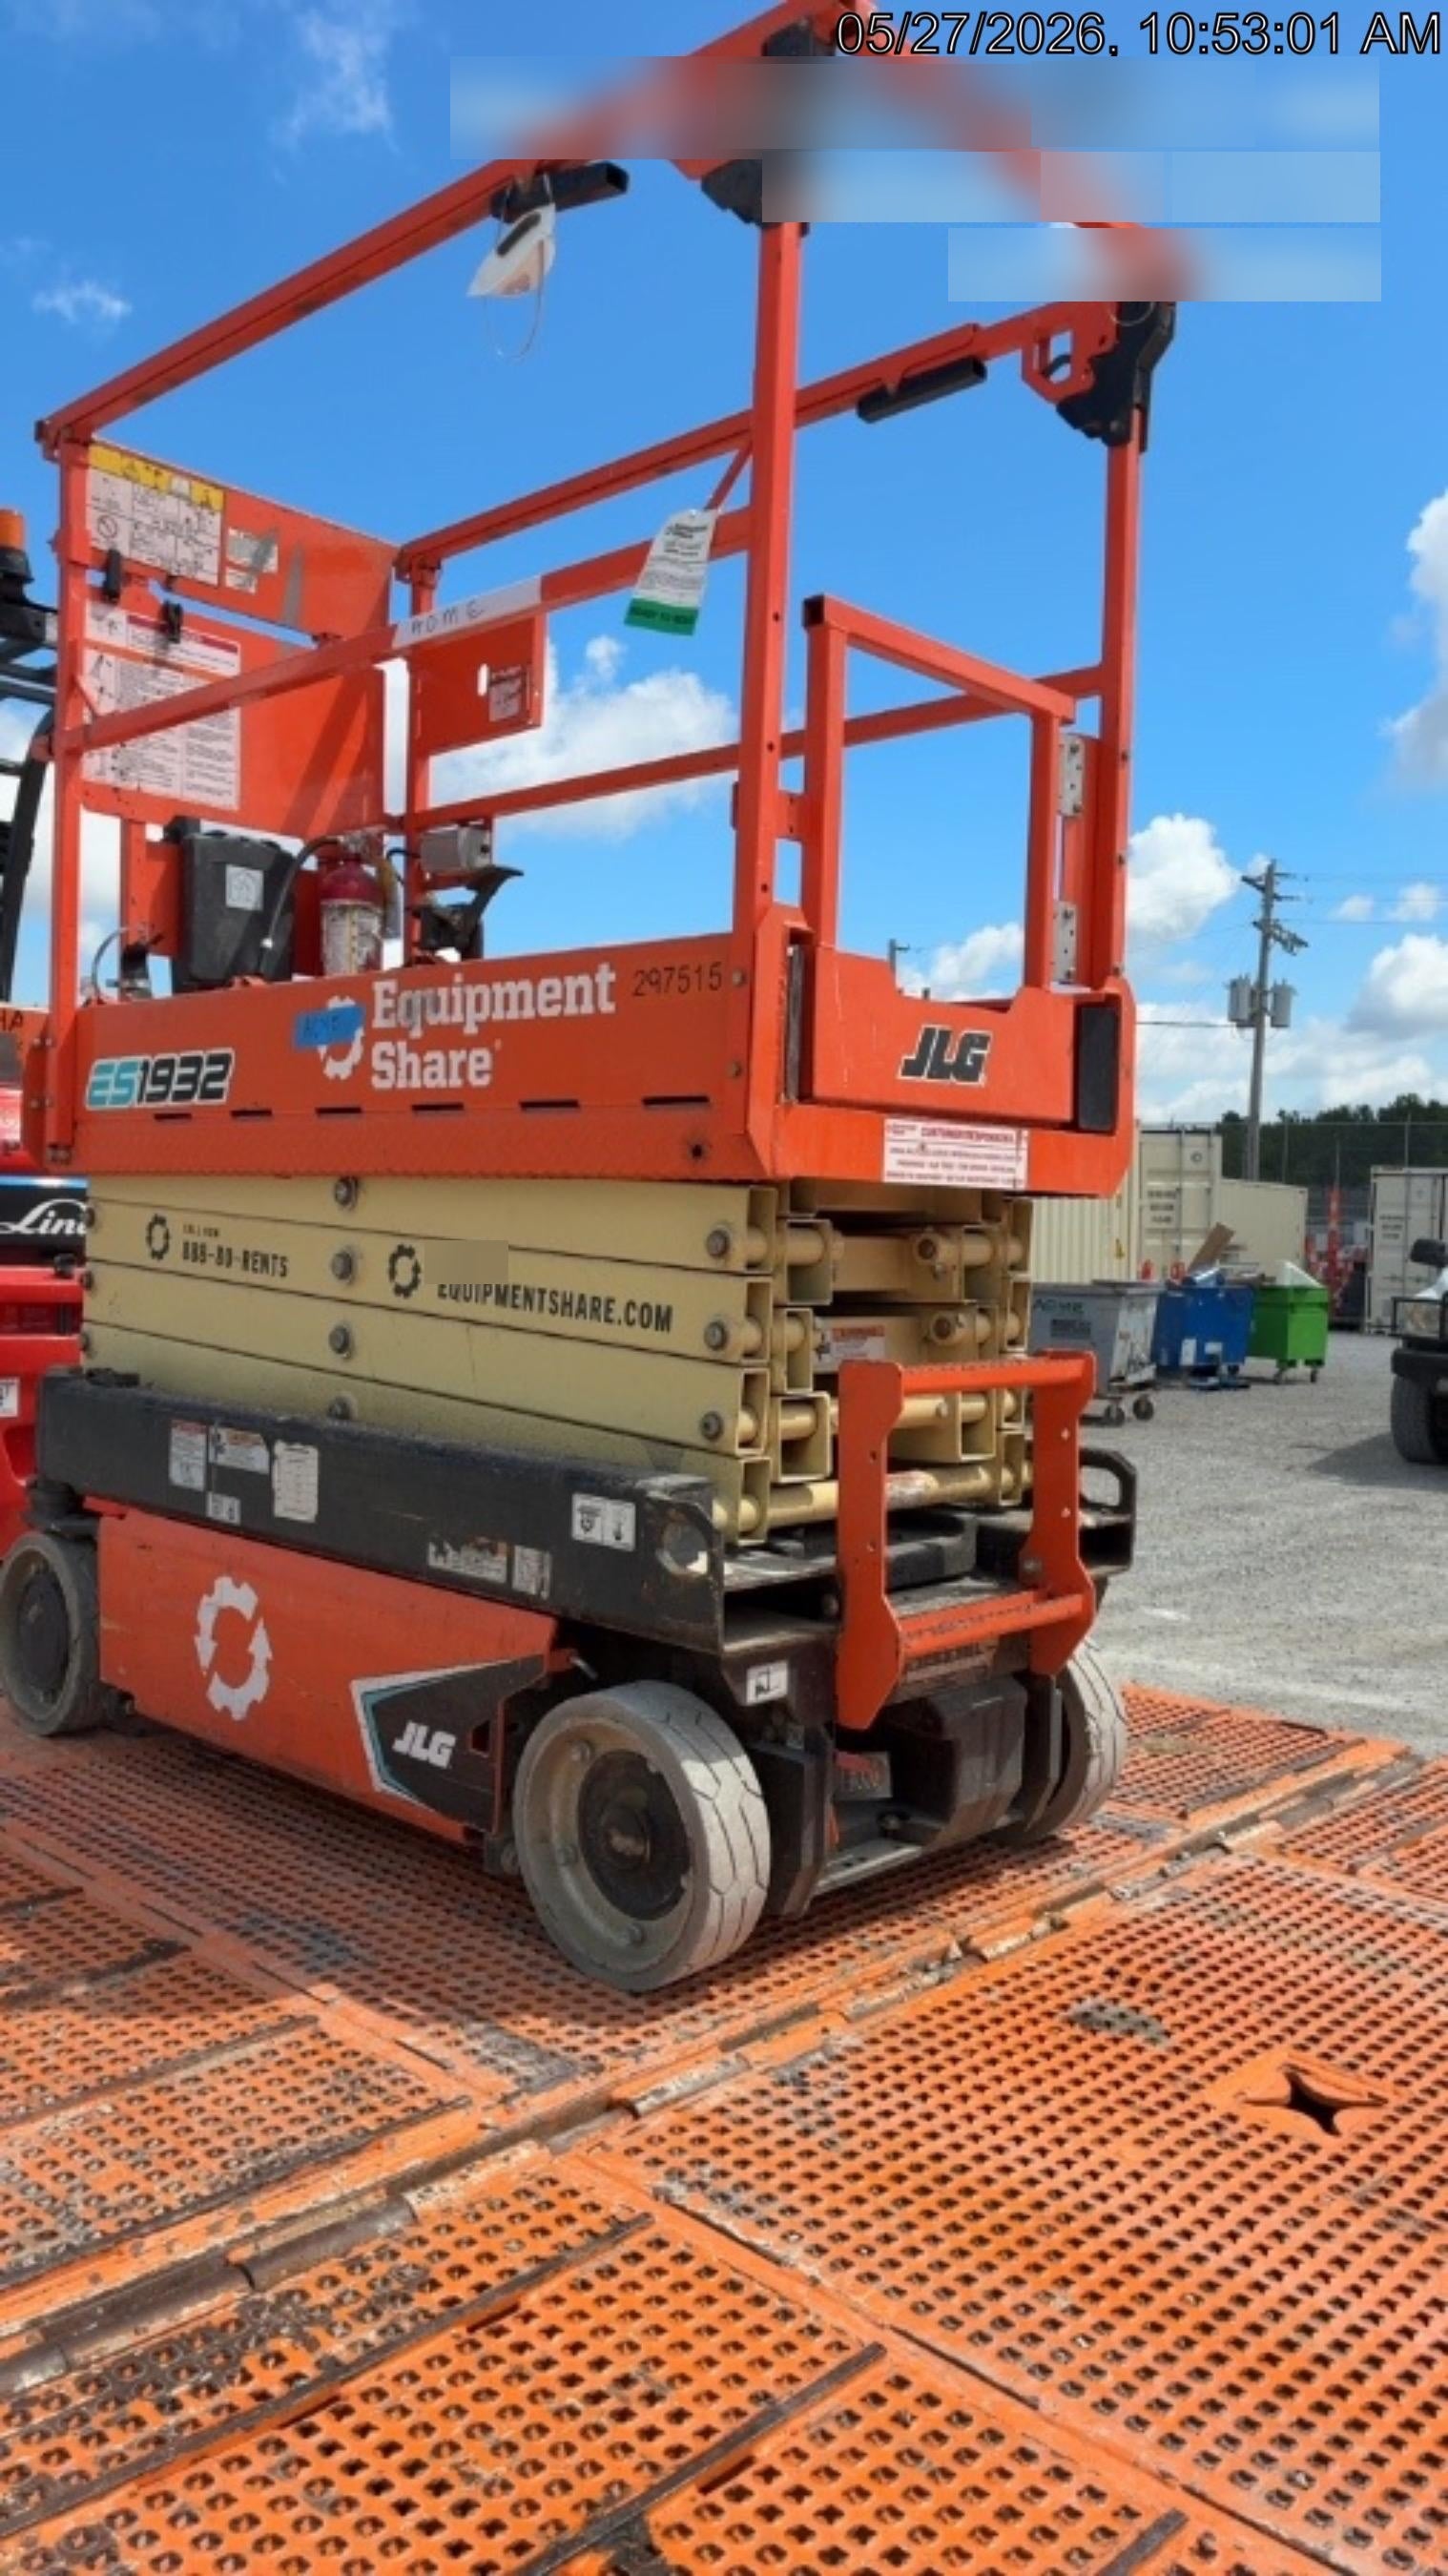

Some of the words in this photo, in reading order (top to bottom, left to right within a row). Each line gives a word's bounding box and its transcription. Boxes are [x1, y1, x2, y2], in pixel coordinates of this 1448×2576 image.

[372, 962, 616, 1039] Equipment
[632, 961, 723, 997] 297515
[86, 1049, 235, 1111] ES1932
[371, 1041, 492, 1090] Share
[899, 1025, 992, 1085] JLG
[437, 1283, 672, 1333] EQUIPMENTSHARE.COM
[391, 1720, 456, 1769] JLG
